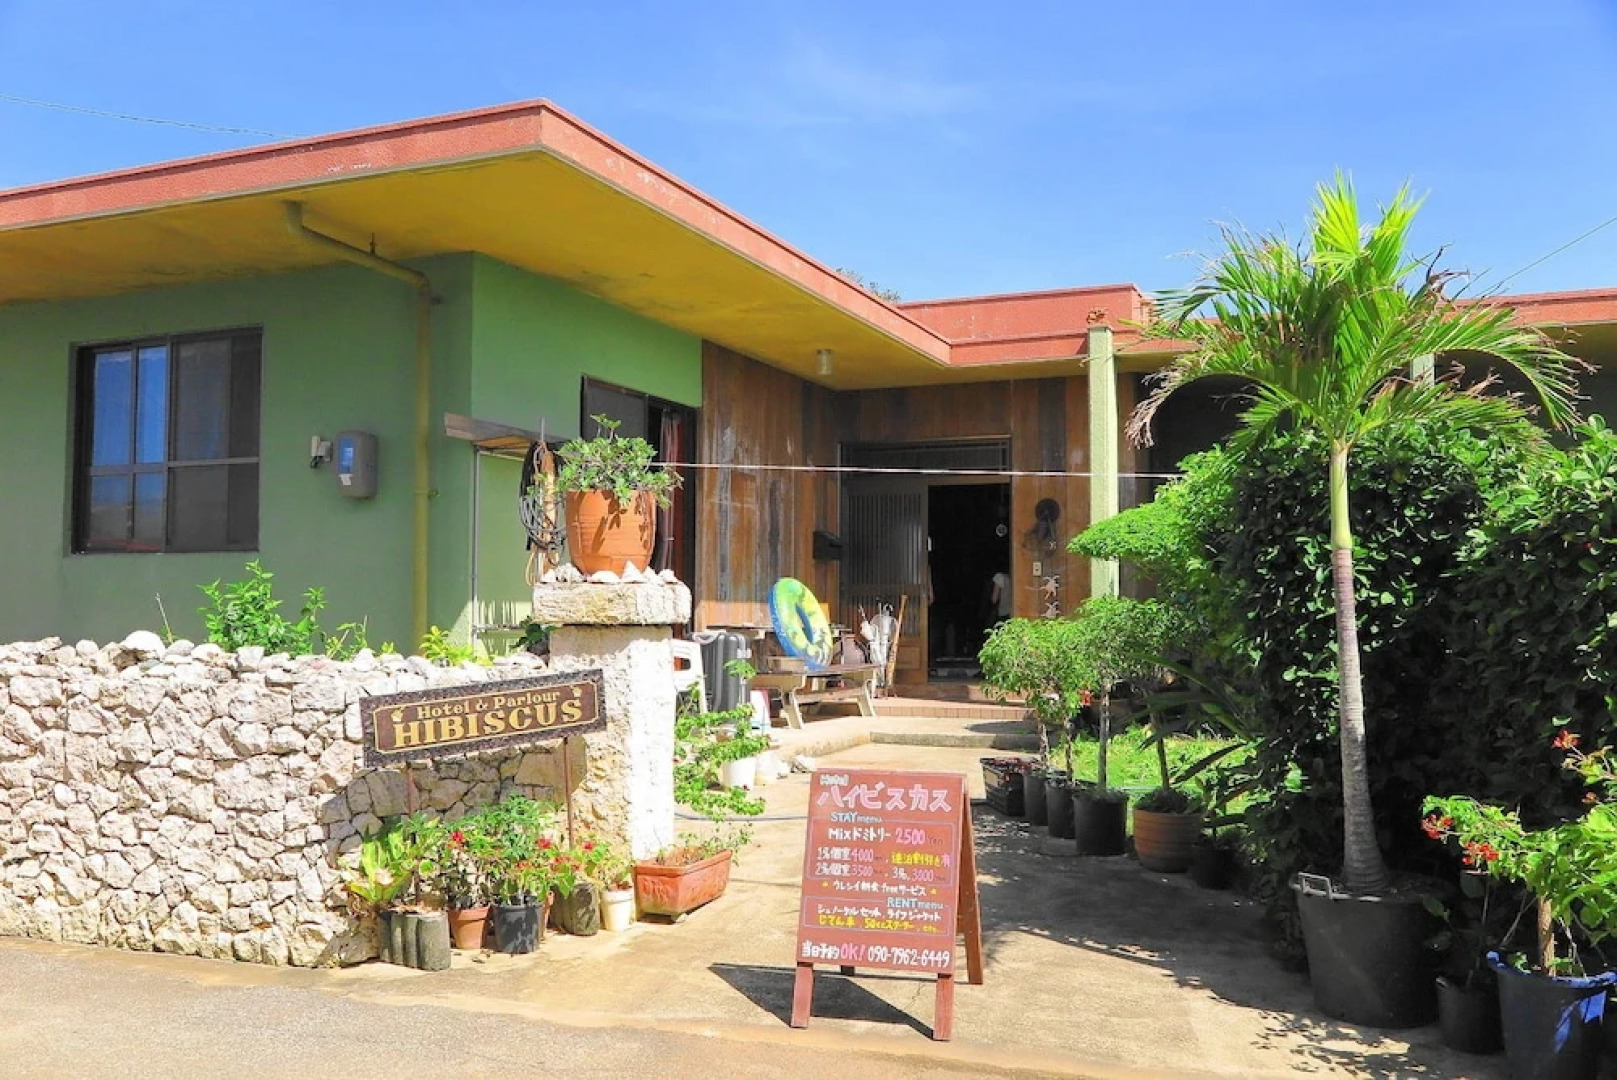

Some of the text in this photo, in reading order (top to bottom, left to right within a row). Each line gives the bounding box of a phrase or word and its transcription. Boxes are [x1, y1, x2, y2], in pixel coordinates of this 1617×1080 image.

[416, 691, 561, 720] Hotel & Parlour
[393, 698, 583, 748] HIBISCUS
[817, 781, 952, 812] ハイビスカス
[895, 828, 925, 845] 2500
[887, 897, 918, 909] RENT
[867, 945, 951, 968] 090-7962-6449
